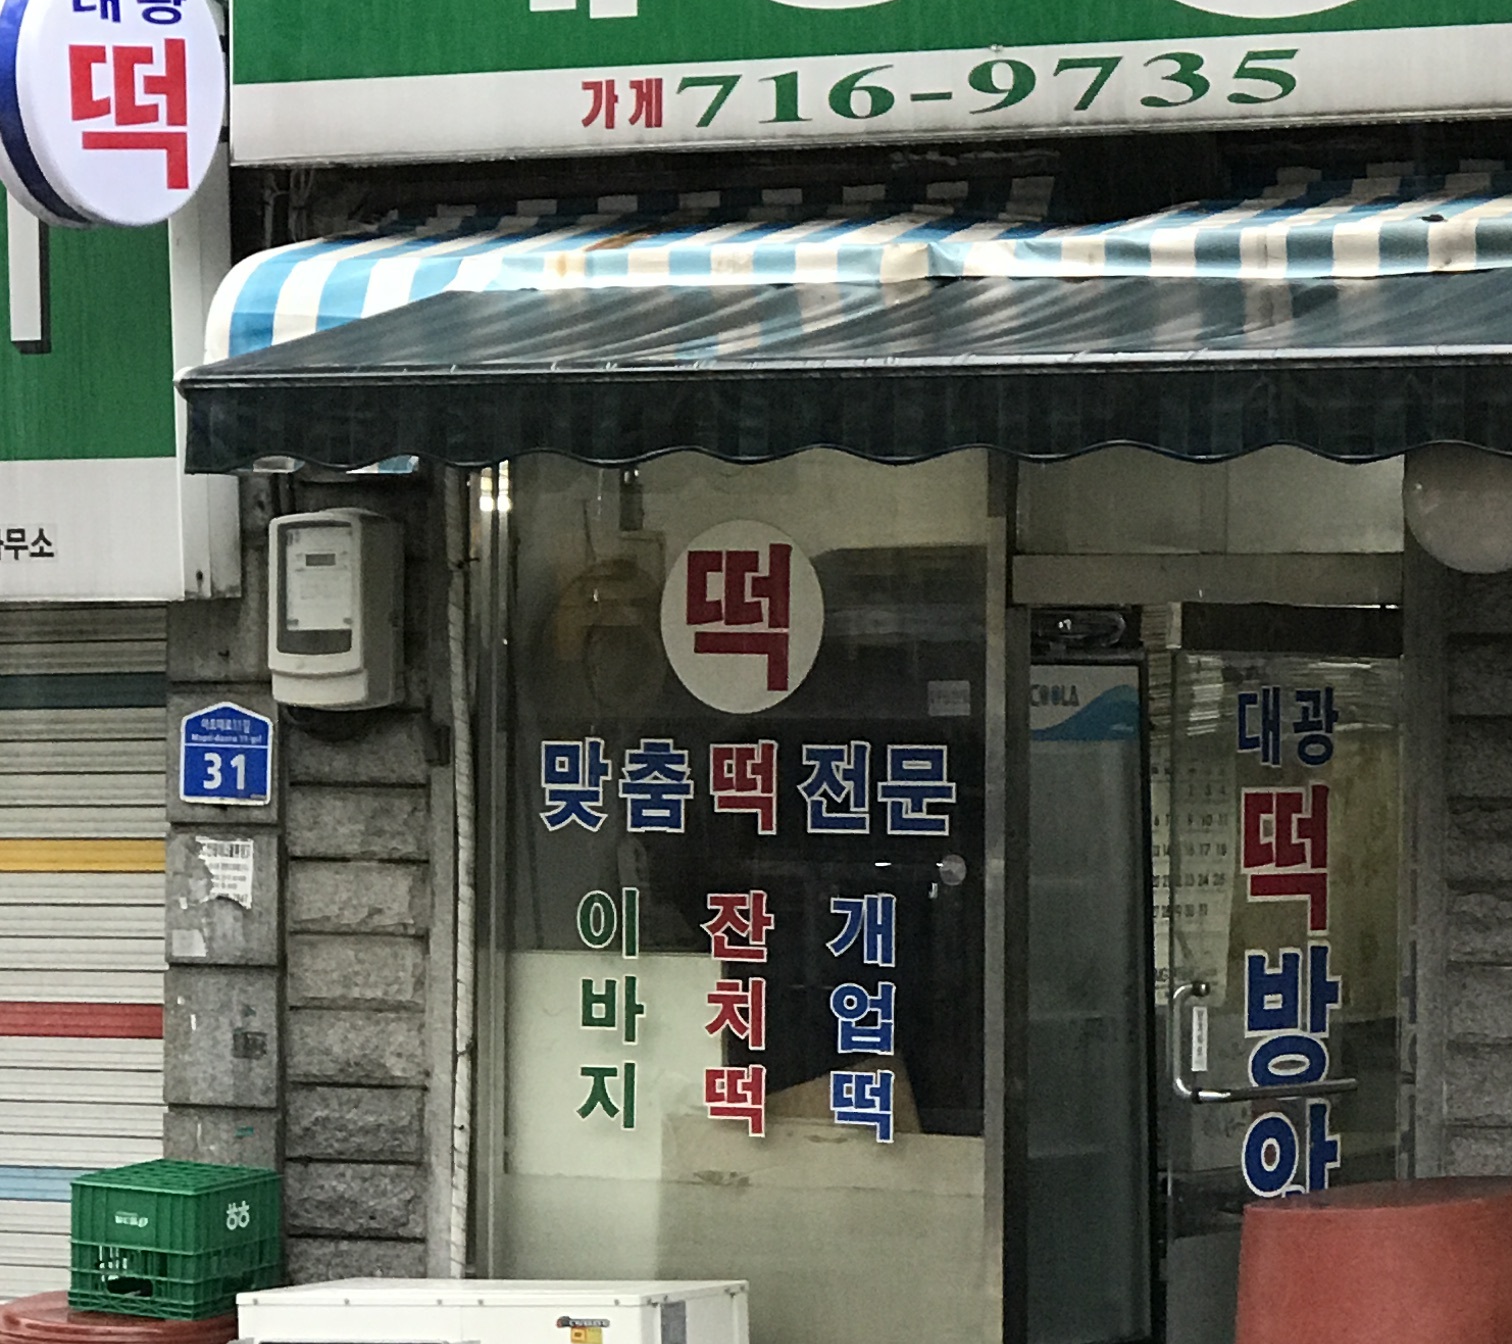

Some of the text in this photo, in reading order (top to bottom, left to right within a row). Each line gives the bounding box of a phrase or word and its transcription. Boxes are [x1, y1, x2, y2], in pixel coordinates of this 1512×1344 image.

[68, 37, 190, 190] 떡
[581, 47, 1299, 130] 가게 716-9735
[0, 528, 54, 560] 무소
[687, 544, 792, 692] 떡
[1237, 686, 1339, 768] 대광
[203, 752, 245, 790] 31
[1241, 779, 1329, 936] 떡
